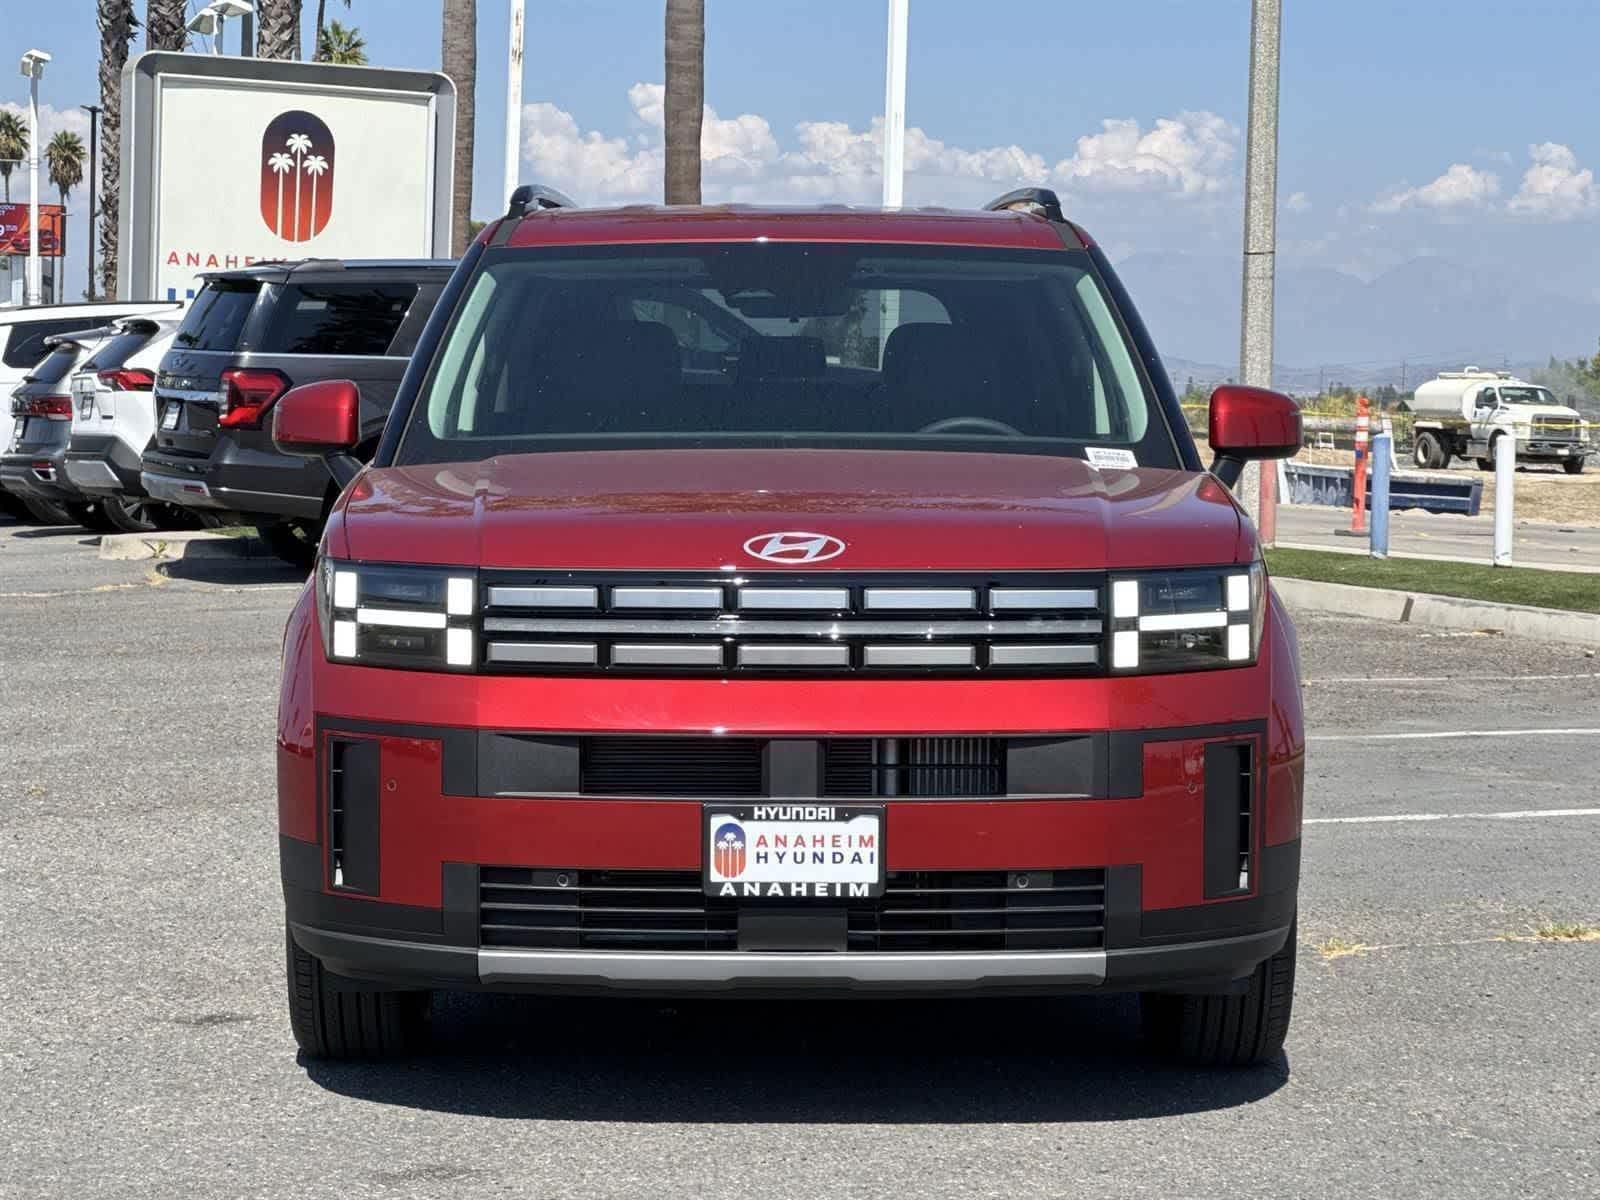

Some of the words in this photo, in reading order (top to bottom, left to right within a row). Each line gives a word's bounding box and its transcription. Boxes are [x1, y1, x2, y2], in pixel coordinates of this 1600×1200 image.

[167, 251, 289, 268] ANAHE
[753, 807, 836, 820] HYUNDAI
[755, 834, 875, 848] ANAHEIM
[755, 851, 875, 865] HYUNDAI
[719, 881, 870, 897] ANAHEIM
